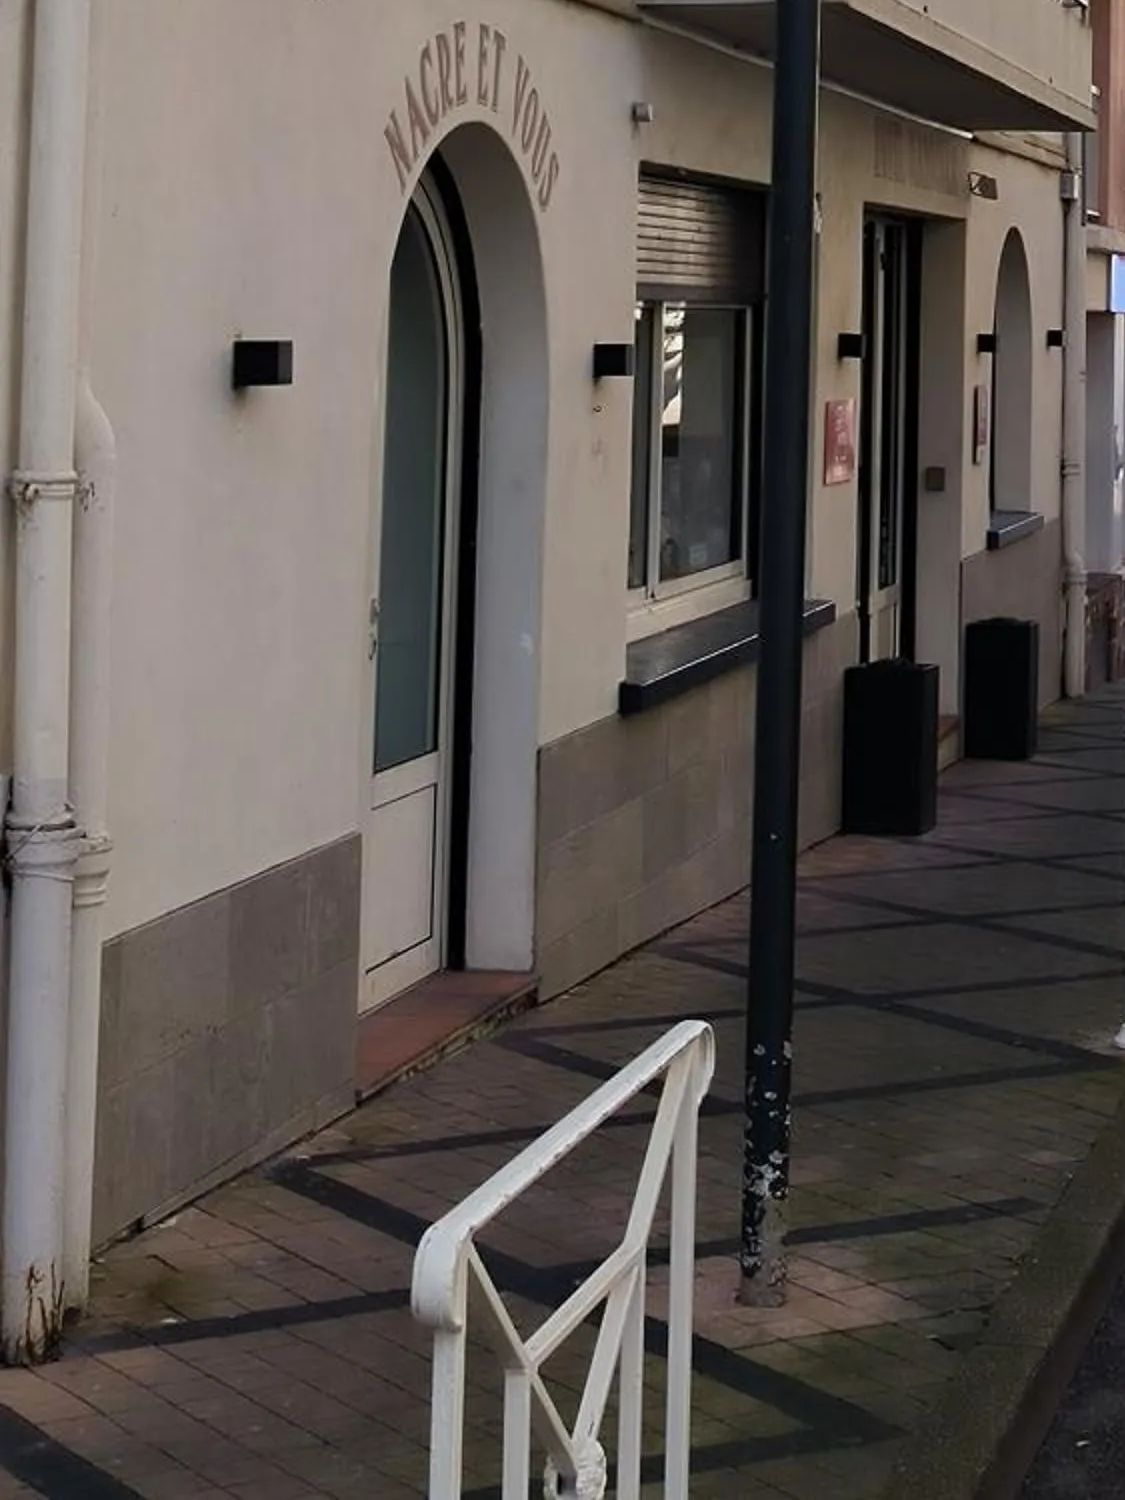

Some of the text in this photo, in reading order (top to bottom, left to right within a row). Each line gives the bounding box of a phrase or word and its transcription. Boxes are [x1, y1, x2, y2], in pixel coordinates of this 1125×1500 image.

[383, 20, 560, 213] NACRE ET VOUS
